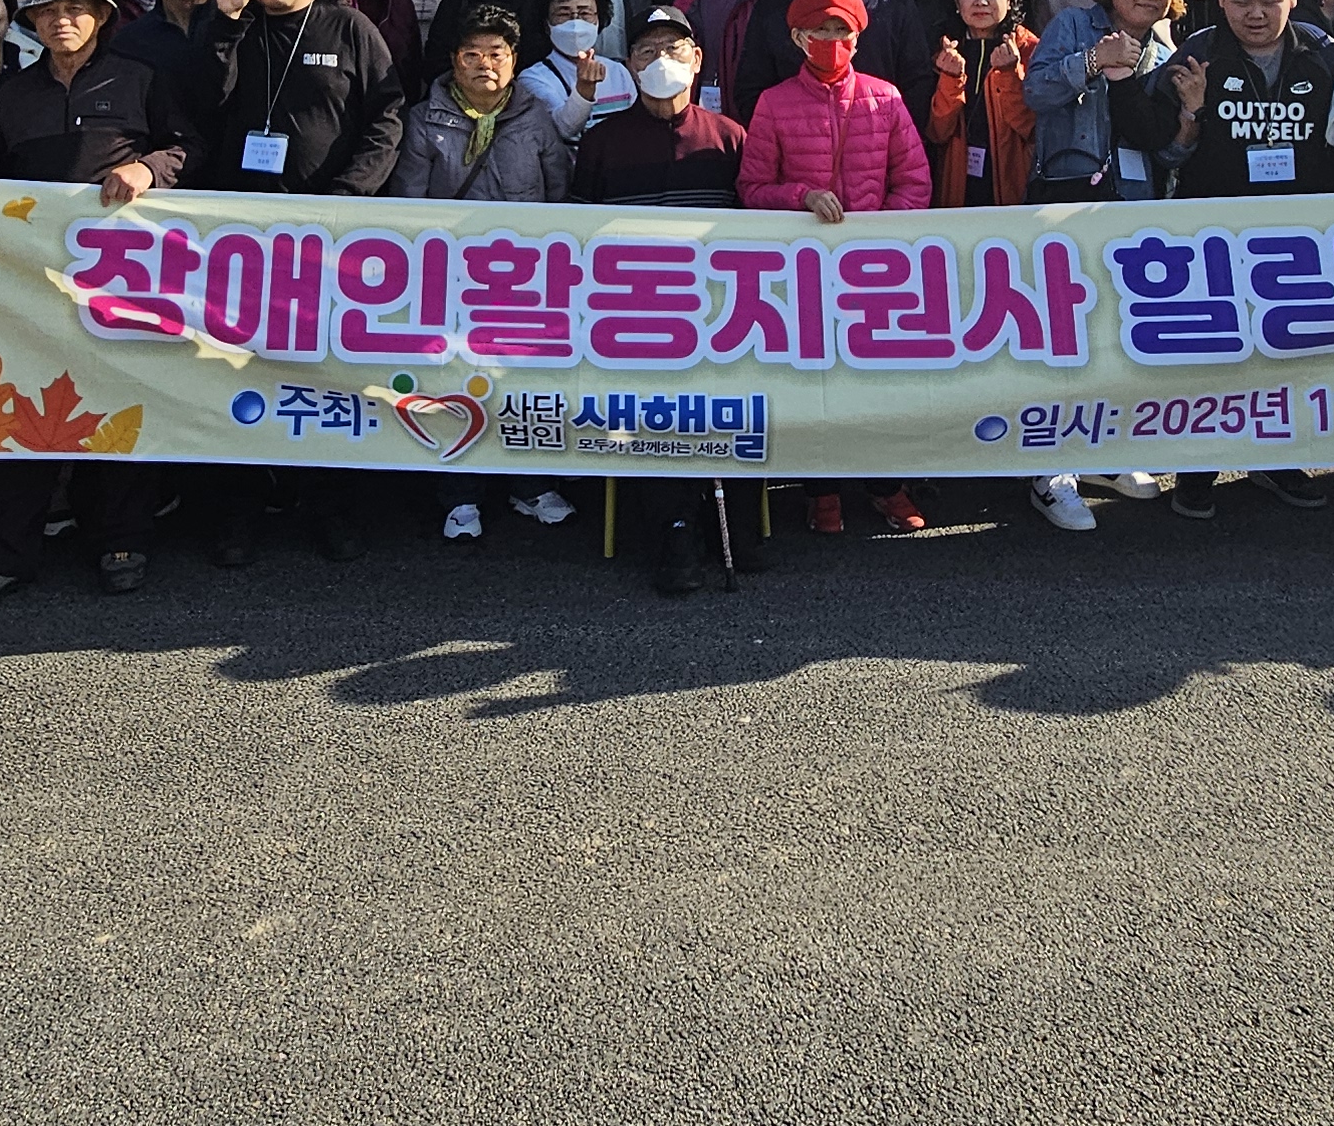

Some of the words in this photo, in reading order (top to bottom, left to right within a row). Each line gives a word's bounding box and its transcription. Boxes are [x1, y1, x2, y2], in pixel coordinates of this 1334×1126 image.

[1218, 100, 1306, 121] OUTDO
[1231, 121, 1315, 141] MYSELF
[70, 225, 1088, 361] 장애인활동지원사
[275, 384, 379, 437] 주최:
[498, 391, 565, 424] 사단
[1021, 402, 1118, 448] 일시:
[1131, 384, 1292, 440] 2025년
[500, 424, 565, 450] 법인
[571, 393, 765, 460] 새해밀
[577, 438, 625, 453] 모두가
[630, 439, 693, 456] 함께하는
[697, 441, 729, 456] 세상
